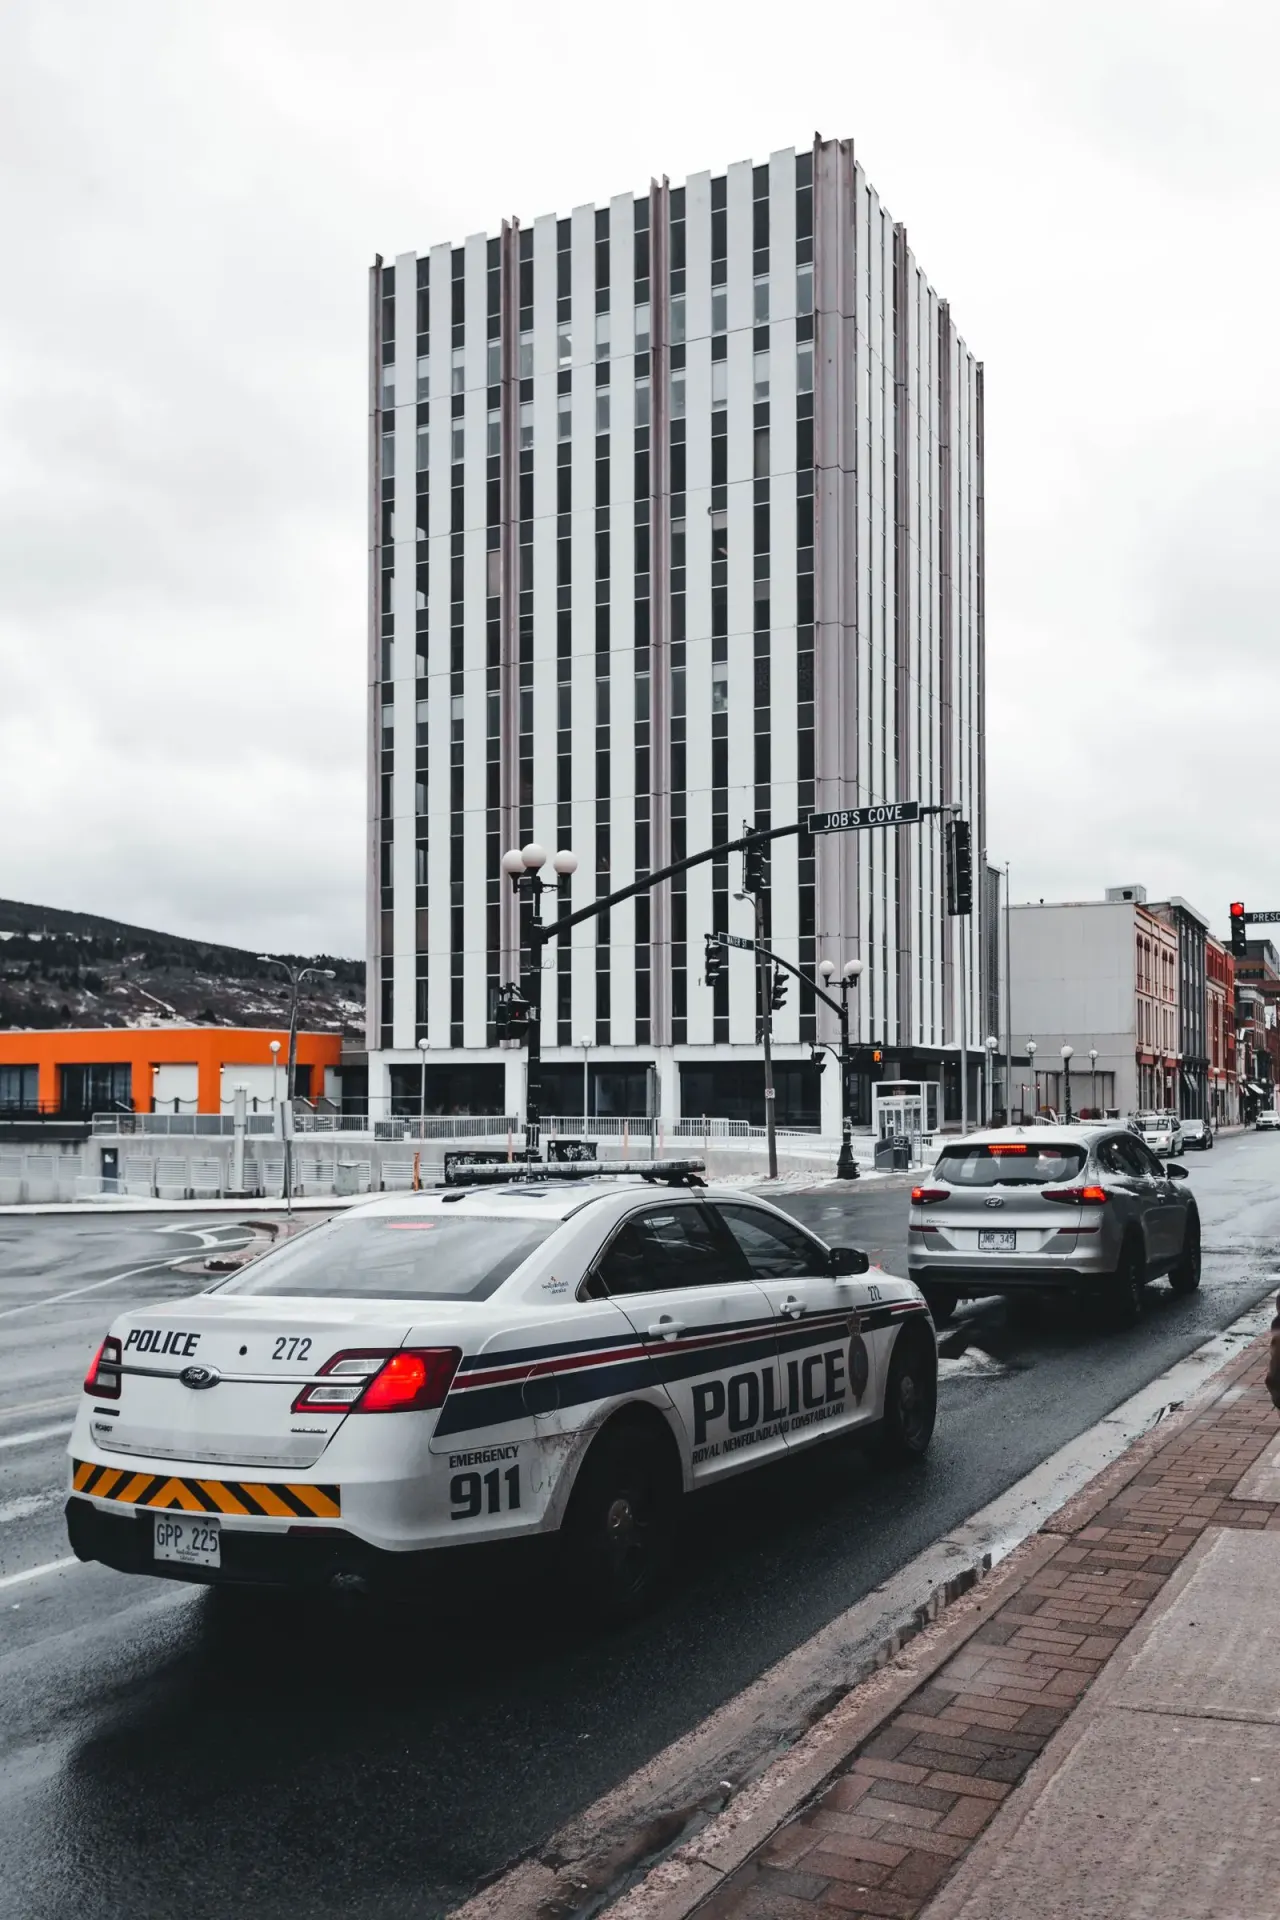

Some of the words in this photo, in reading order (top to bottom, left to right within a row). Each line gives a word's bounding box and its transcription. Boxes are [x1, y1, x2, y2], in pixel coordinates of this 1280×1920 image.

[824, 810, 861, 829] JOB'S
[868, 805, 903, 823] COVE
[1252, 912, 1280, 922] PRESC
[980, 1234, 995, 1244] JMR
[1000, 1234, 1015, 1244] 345
[867, 1285, 883, 1302] 272
[123, 1329, 201, 1357] POLICE
[271, 1337, 313, 1361] 272
[691, 1348, 846, 1446] POLICE
[692, 1443, 721, 1465] ROYAL
[722, 1420, 790, 1454] NEWFOUNDLAND
[791, 1402, 845, 1430] CONSTABULARY
[448, 1445, 520, 1469] EMERGENCY
[450, 1464, 521, 1520] 911
[156, 1523, 183, 1548] GPP
[191, 1527, 218, 1552] 225
